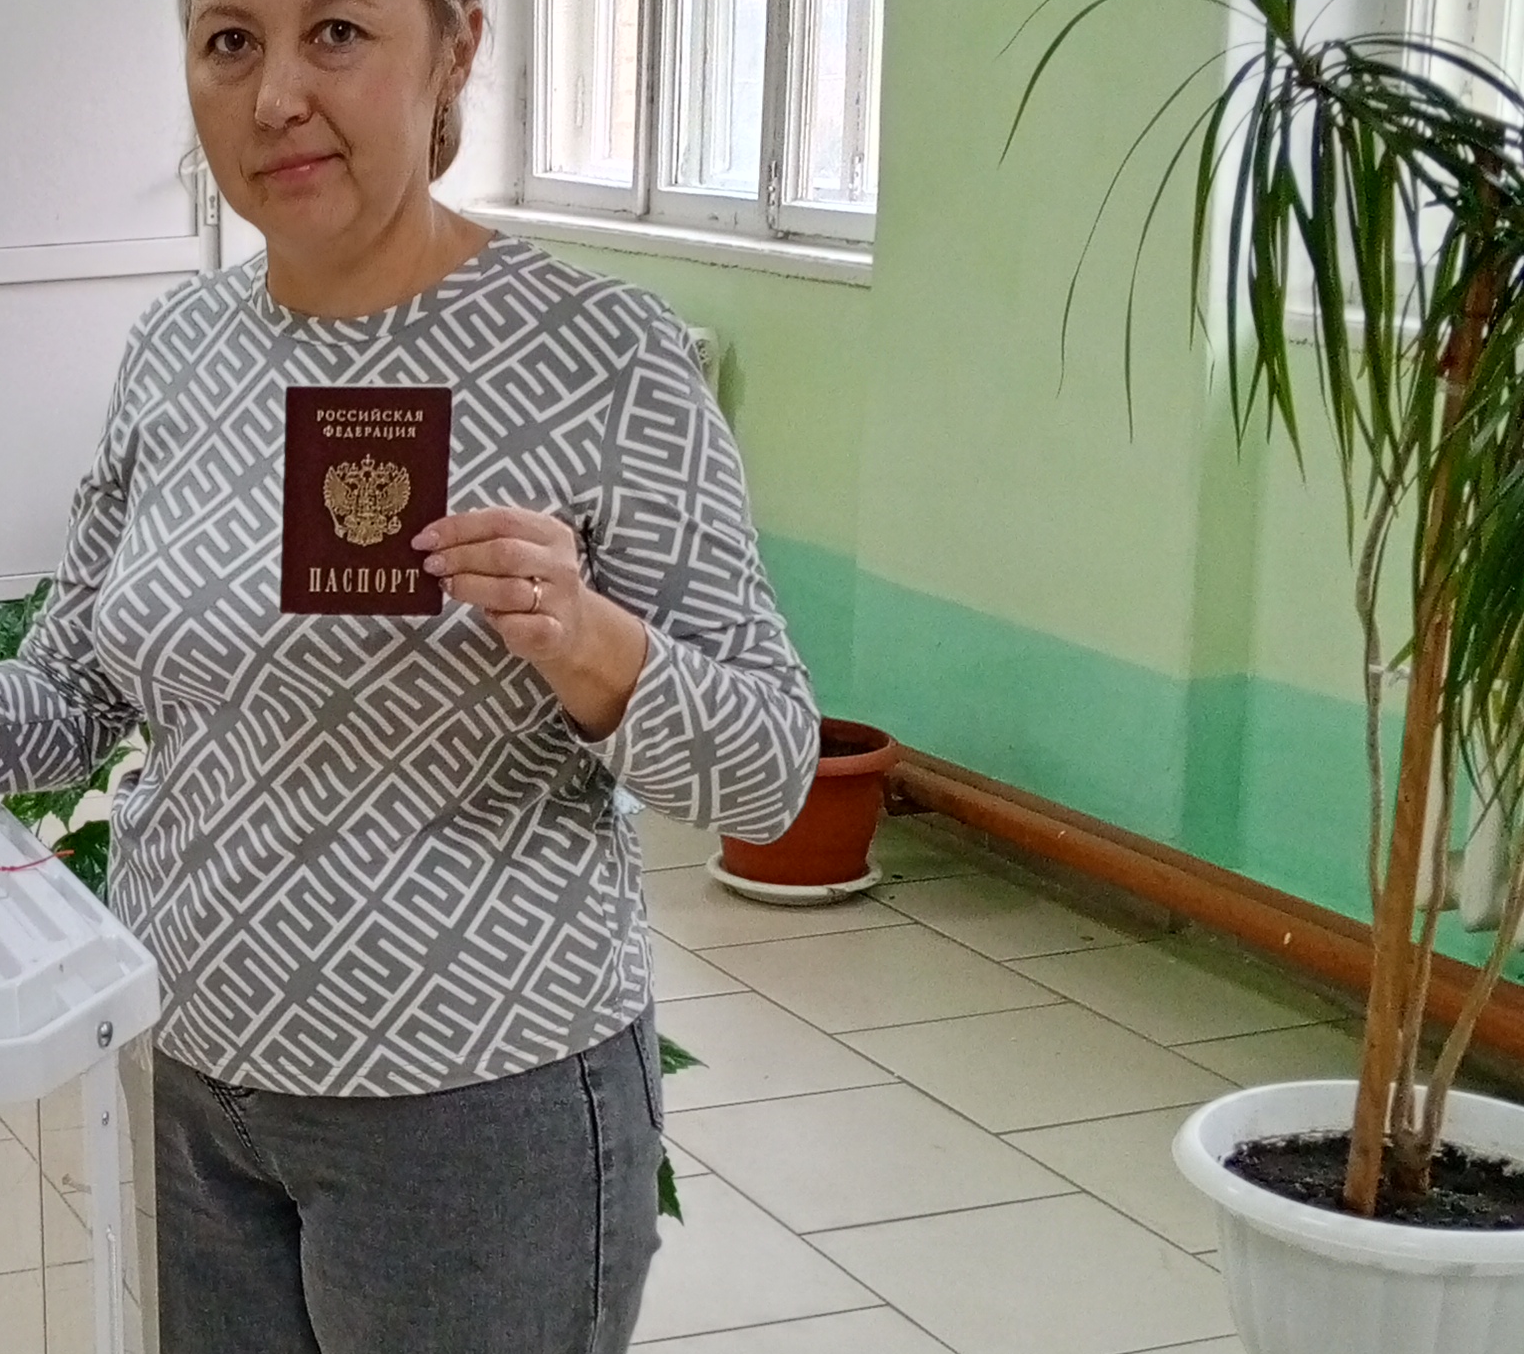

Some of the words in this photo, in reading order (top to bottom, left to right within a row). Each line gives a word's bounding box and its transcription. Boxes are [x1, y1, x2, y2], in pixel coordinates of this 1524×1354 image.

[316, 408, 424, 423] РОССИЙСКАЯ
[322, 425, 417, 440] ФЕДЕРАЦИЯ
[308, 567, 420, 593] ПАСПОРТ
